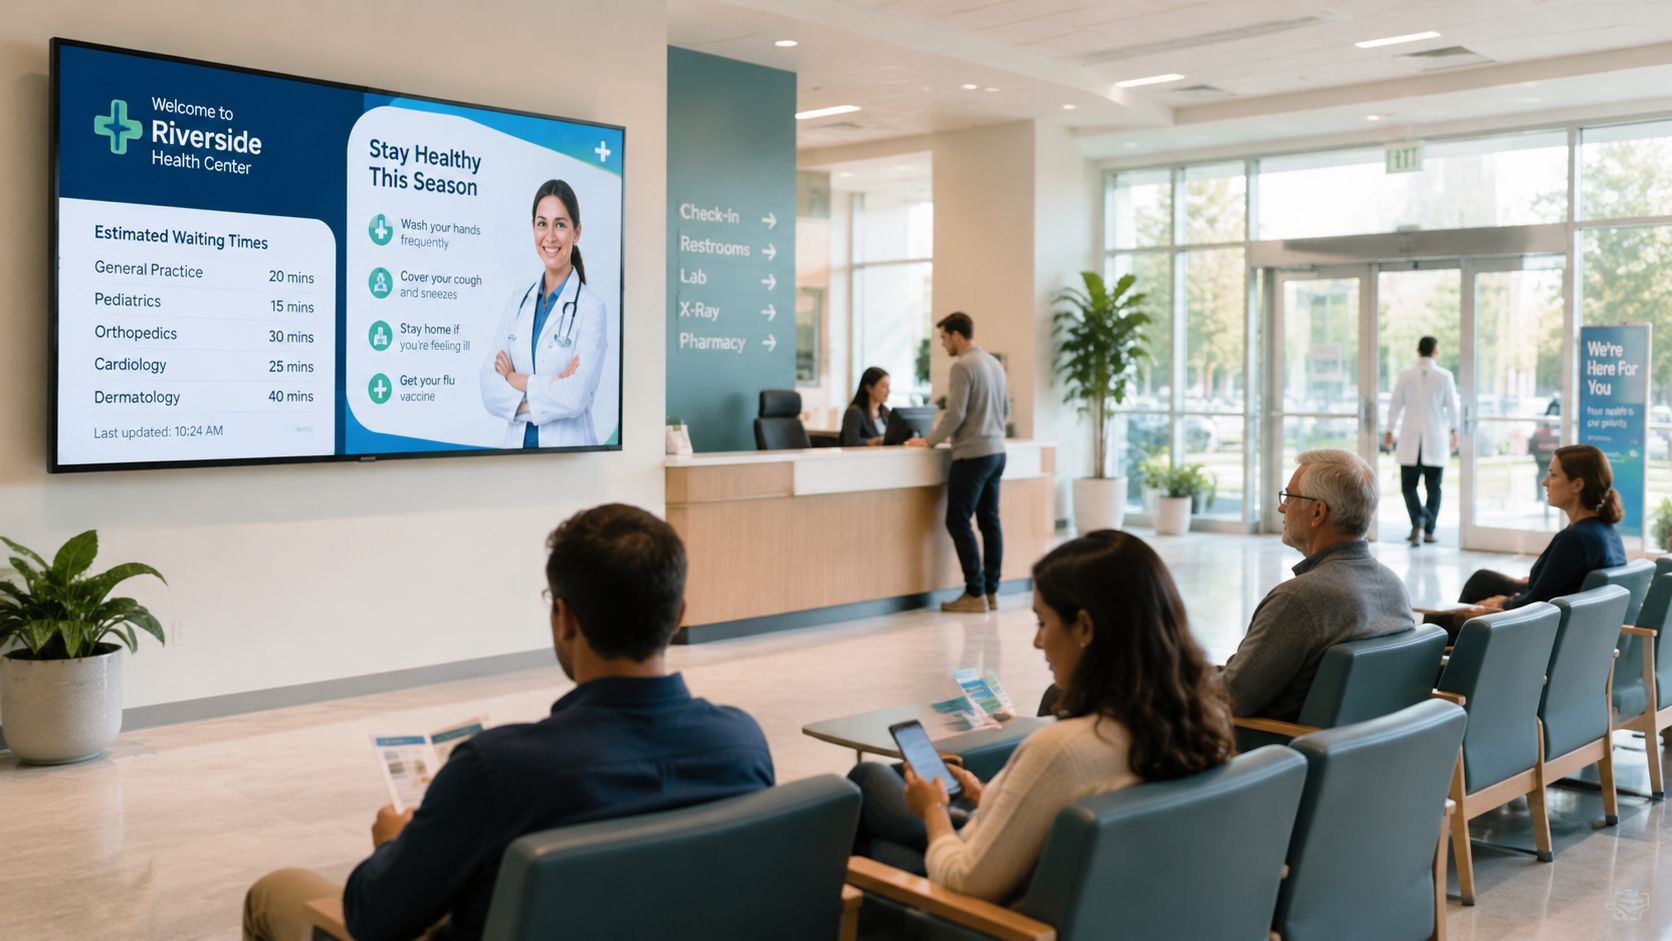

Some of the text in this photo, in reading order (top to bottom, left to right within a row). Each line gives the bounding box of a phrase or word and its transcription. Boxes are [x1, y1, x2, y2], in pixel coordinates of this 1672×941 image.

[152, 97, 233, 120] Welcome to
[153, 120, 261, 154] Riverside
[153, 150, 251, 174] Health Center
[369, 139, 481, 175] Stay Healthy
[369, 166, 477, 196] This Season
[401, 218, 481, 236] Wash your hands
[96, 225, 268, 250] Estimated Waiting Times
[401, 234, 449, 251] frequently
[680, 235, 751, 257] Restrooms
[95, 260, 203, 278] General Practice
[269, 270, 314, 284] 20 mins
[680, 268, 708, 285] Lab
[400, 270, 482, 287] Cover your cough
[95, 293, 161, 307] Pediatrics
[400, 287, 458, 300] and sneezes
[271, 300, 314, 313] 15 mins
[679, 301, 720, 322] X-Ray
[95, 325, 177, 341] Orthopedics
[269, 330, 314, 343] 30 mins
[400, 323, 460, 336] Stay home if
[431, 340, 461, 354] feeling
[463, 340, 471, 351] ill
[679, 332, 747, 354] Pharmacy
[1587, 341, 1624, 357] We're
[95, 357, 166, 374] Cardiology
[269, 360, 313, 372] 25 mins
[1587, 360, 1639, 376] Here For
[400, 375, 455, 388] Get your flu
[1588, 379, 1612, 396] You
[95, 390, 180, 406] Dermatology
[269, 390, 313, 402] 40 mins
[400, 391, 435, 401] vaccine
[94, 425, 223, 440] Last updated: 10:24 AM
